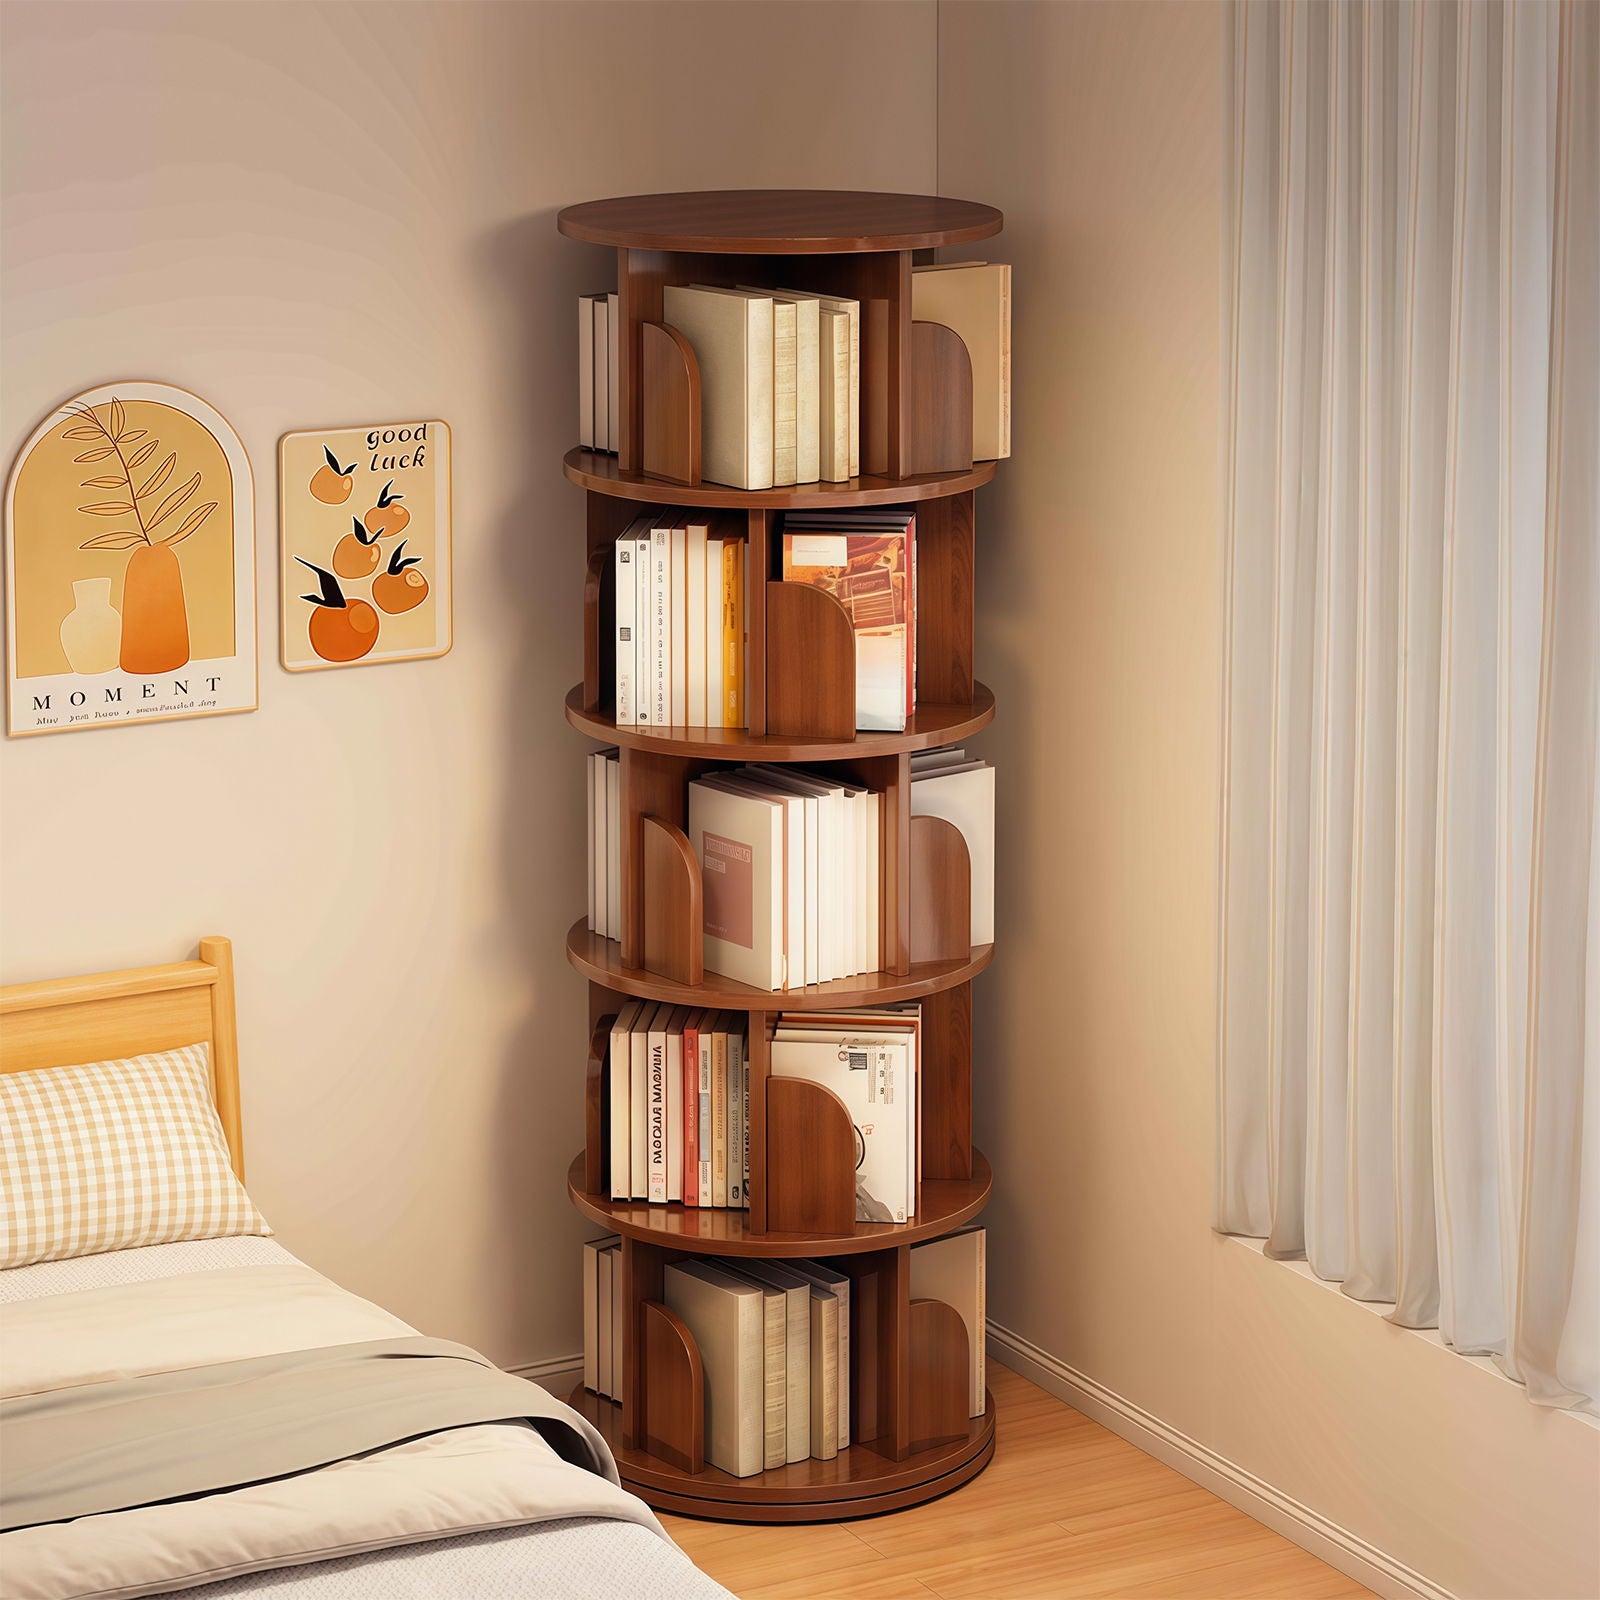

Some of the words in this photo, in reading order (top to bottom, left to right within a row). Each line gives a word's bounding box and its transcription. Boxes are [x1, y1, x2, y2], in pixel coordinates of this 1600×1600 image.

[366, 423, 427, 452] good
[370, 445, 426, 472] luck
[32, 676, 221, 711] MOMENT
